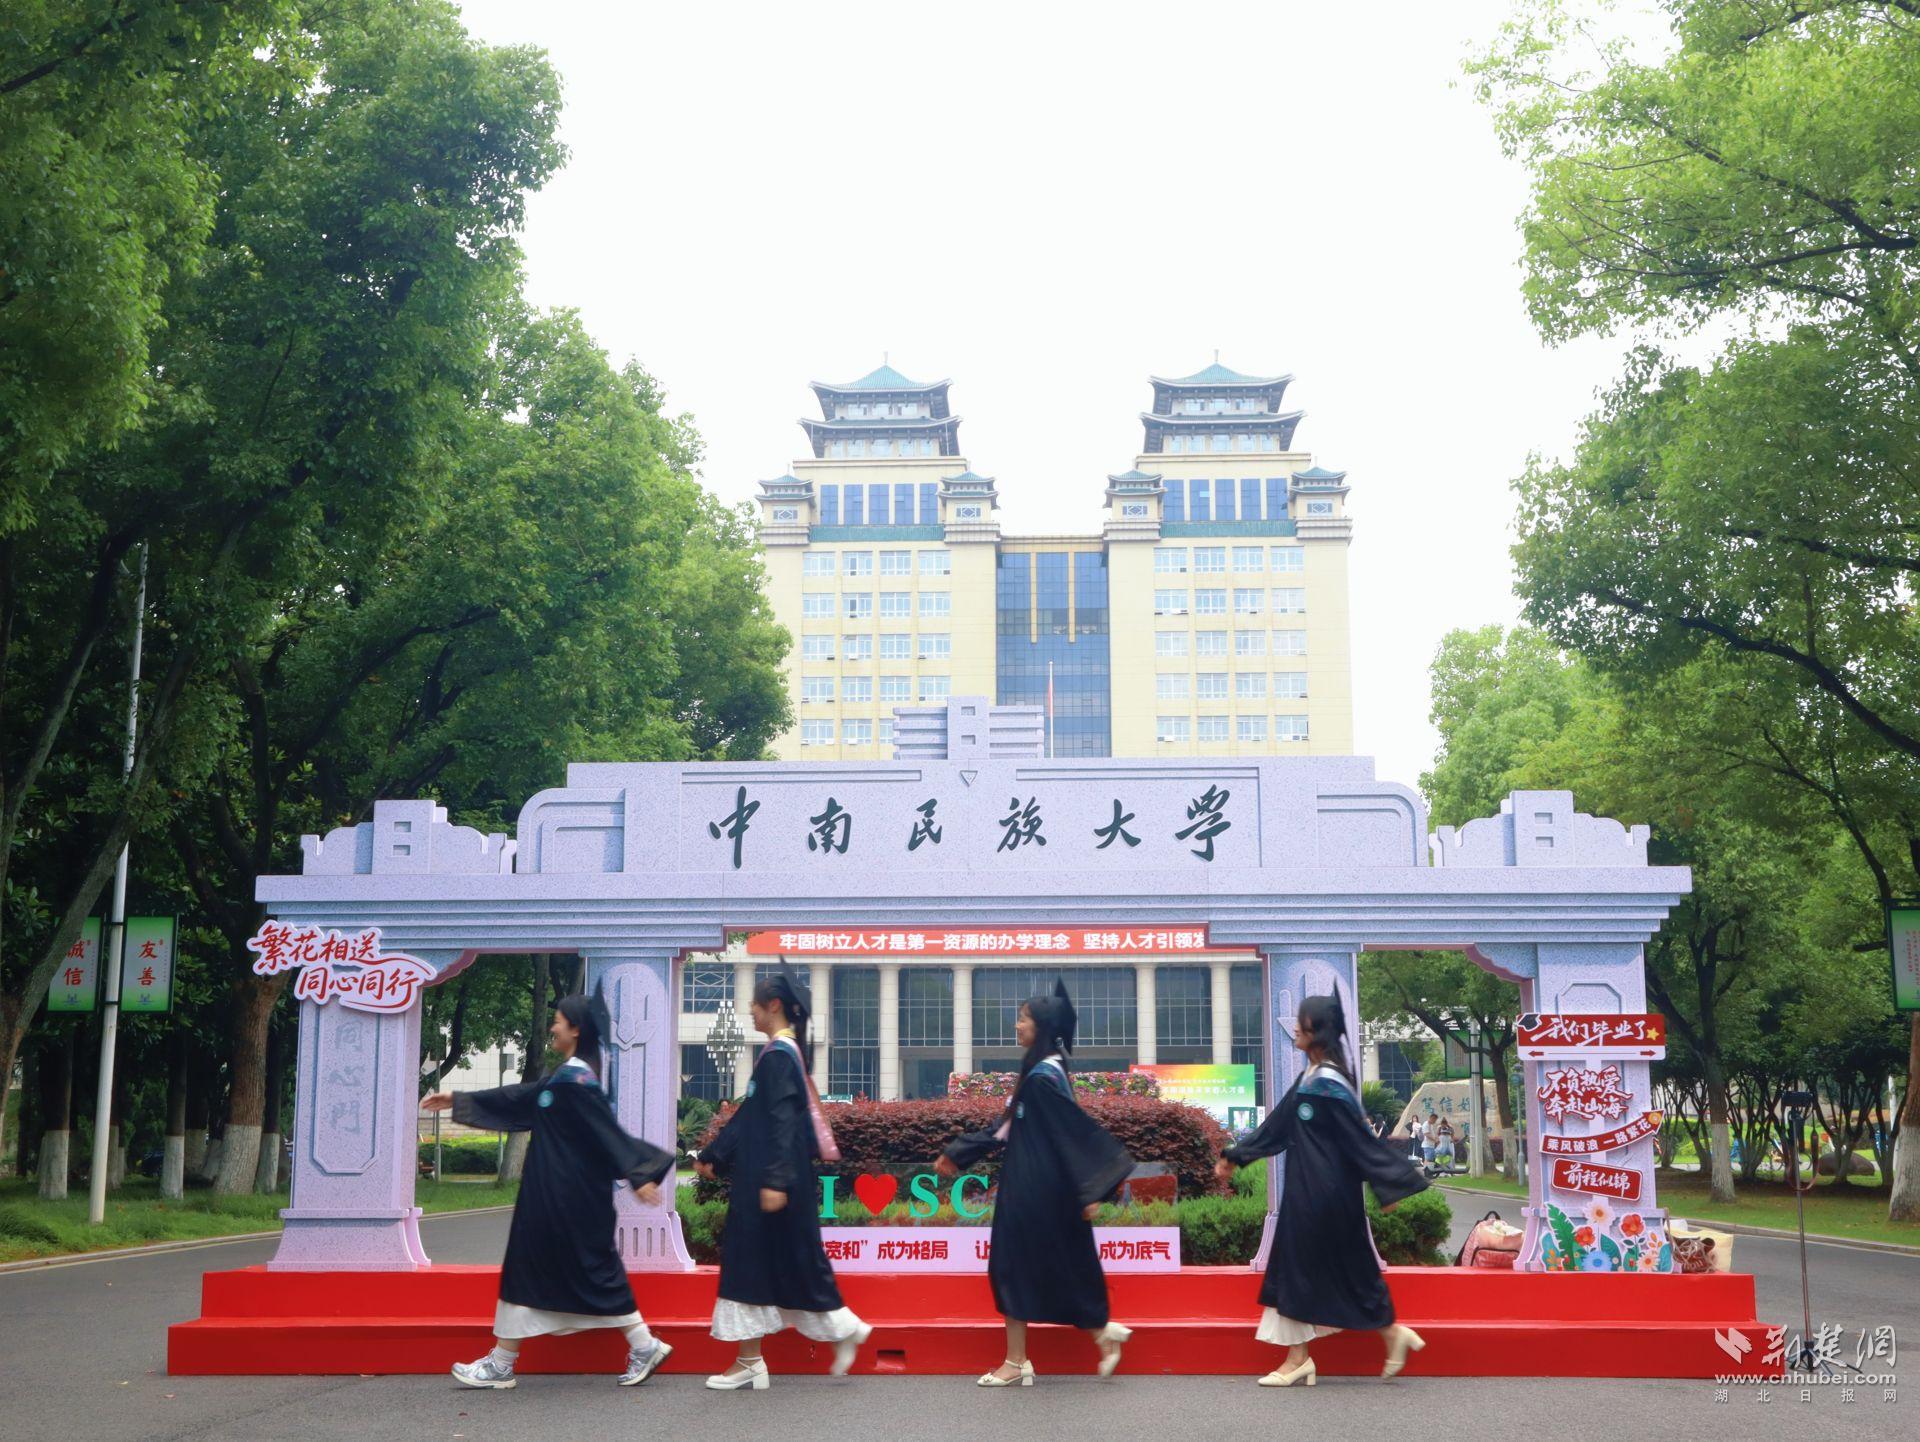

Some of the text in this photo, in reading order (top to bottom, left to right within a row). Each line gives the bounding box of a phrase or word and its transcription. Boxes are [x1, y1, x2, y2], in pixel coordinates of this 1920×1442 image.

[251, 924, 410, 972] 繁花相送
[779, 932, 1071, 951] 牢固树立人才是第一资源的办学理念
[137, 940, 158, 986] 友善
[298, 966, 420, 1009] 同心同行
[1529, 1016, 1646, 1046] 我们毕业了
[1538, 1065, 1633, 1099] 不负热爱
[1545, 1095, 1628, 1125] 奔赴山海
[1547, 1118, 1652, 1152] 乘风破浪 一路繁花
[1562, 1161, 1631, 1198] 前程似锦
[818, 1175, 840, 1219] I
[1099, 1240, 1171, 1260] 成为底气
